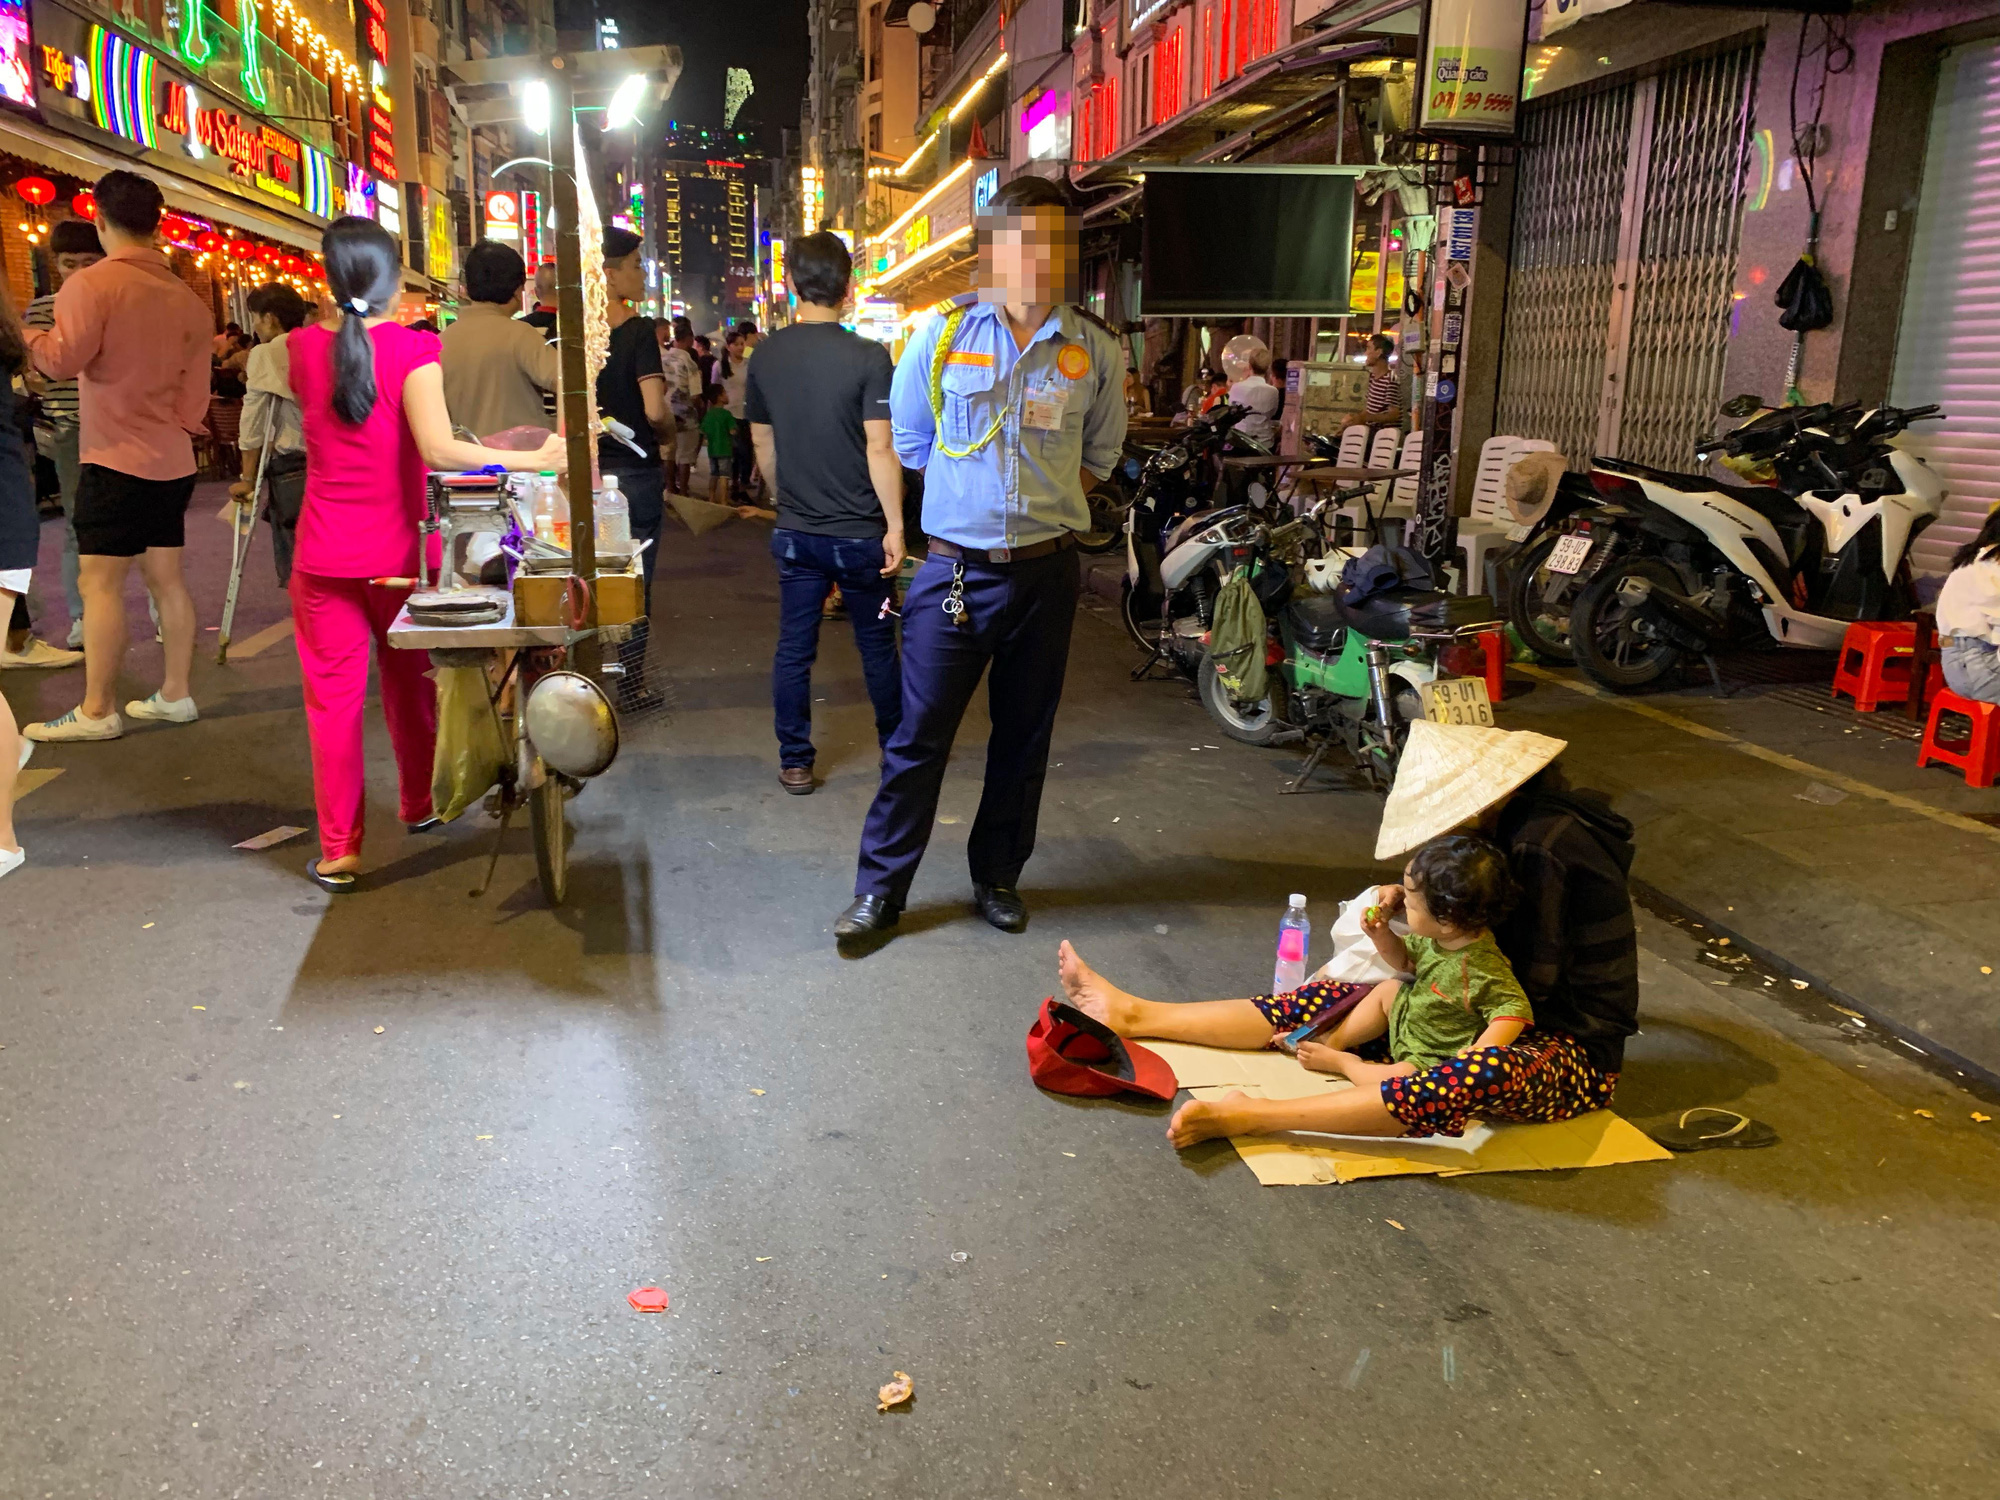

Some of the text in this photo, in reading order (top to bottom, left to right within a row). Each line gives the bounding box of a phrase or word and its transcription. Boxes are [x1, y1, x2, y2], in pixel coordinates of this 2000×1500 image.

[42, 45, 73, 91] Tiger
[215, 108, 267, 176] Saigon
[261, 125, 298, 161] RESTAURANT
[1454, 210, 1474, 225] 138
[1452, 226, 1472, 239] 011
[1450, 240, 1471, 259] 0937
[1560, 538, 1586, 555] 59-U2
[1431, 682, 1477, 704] 59-U1
